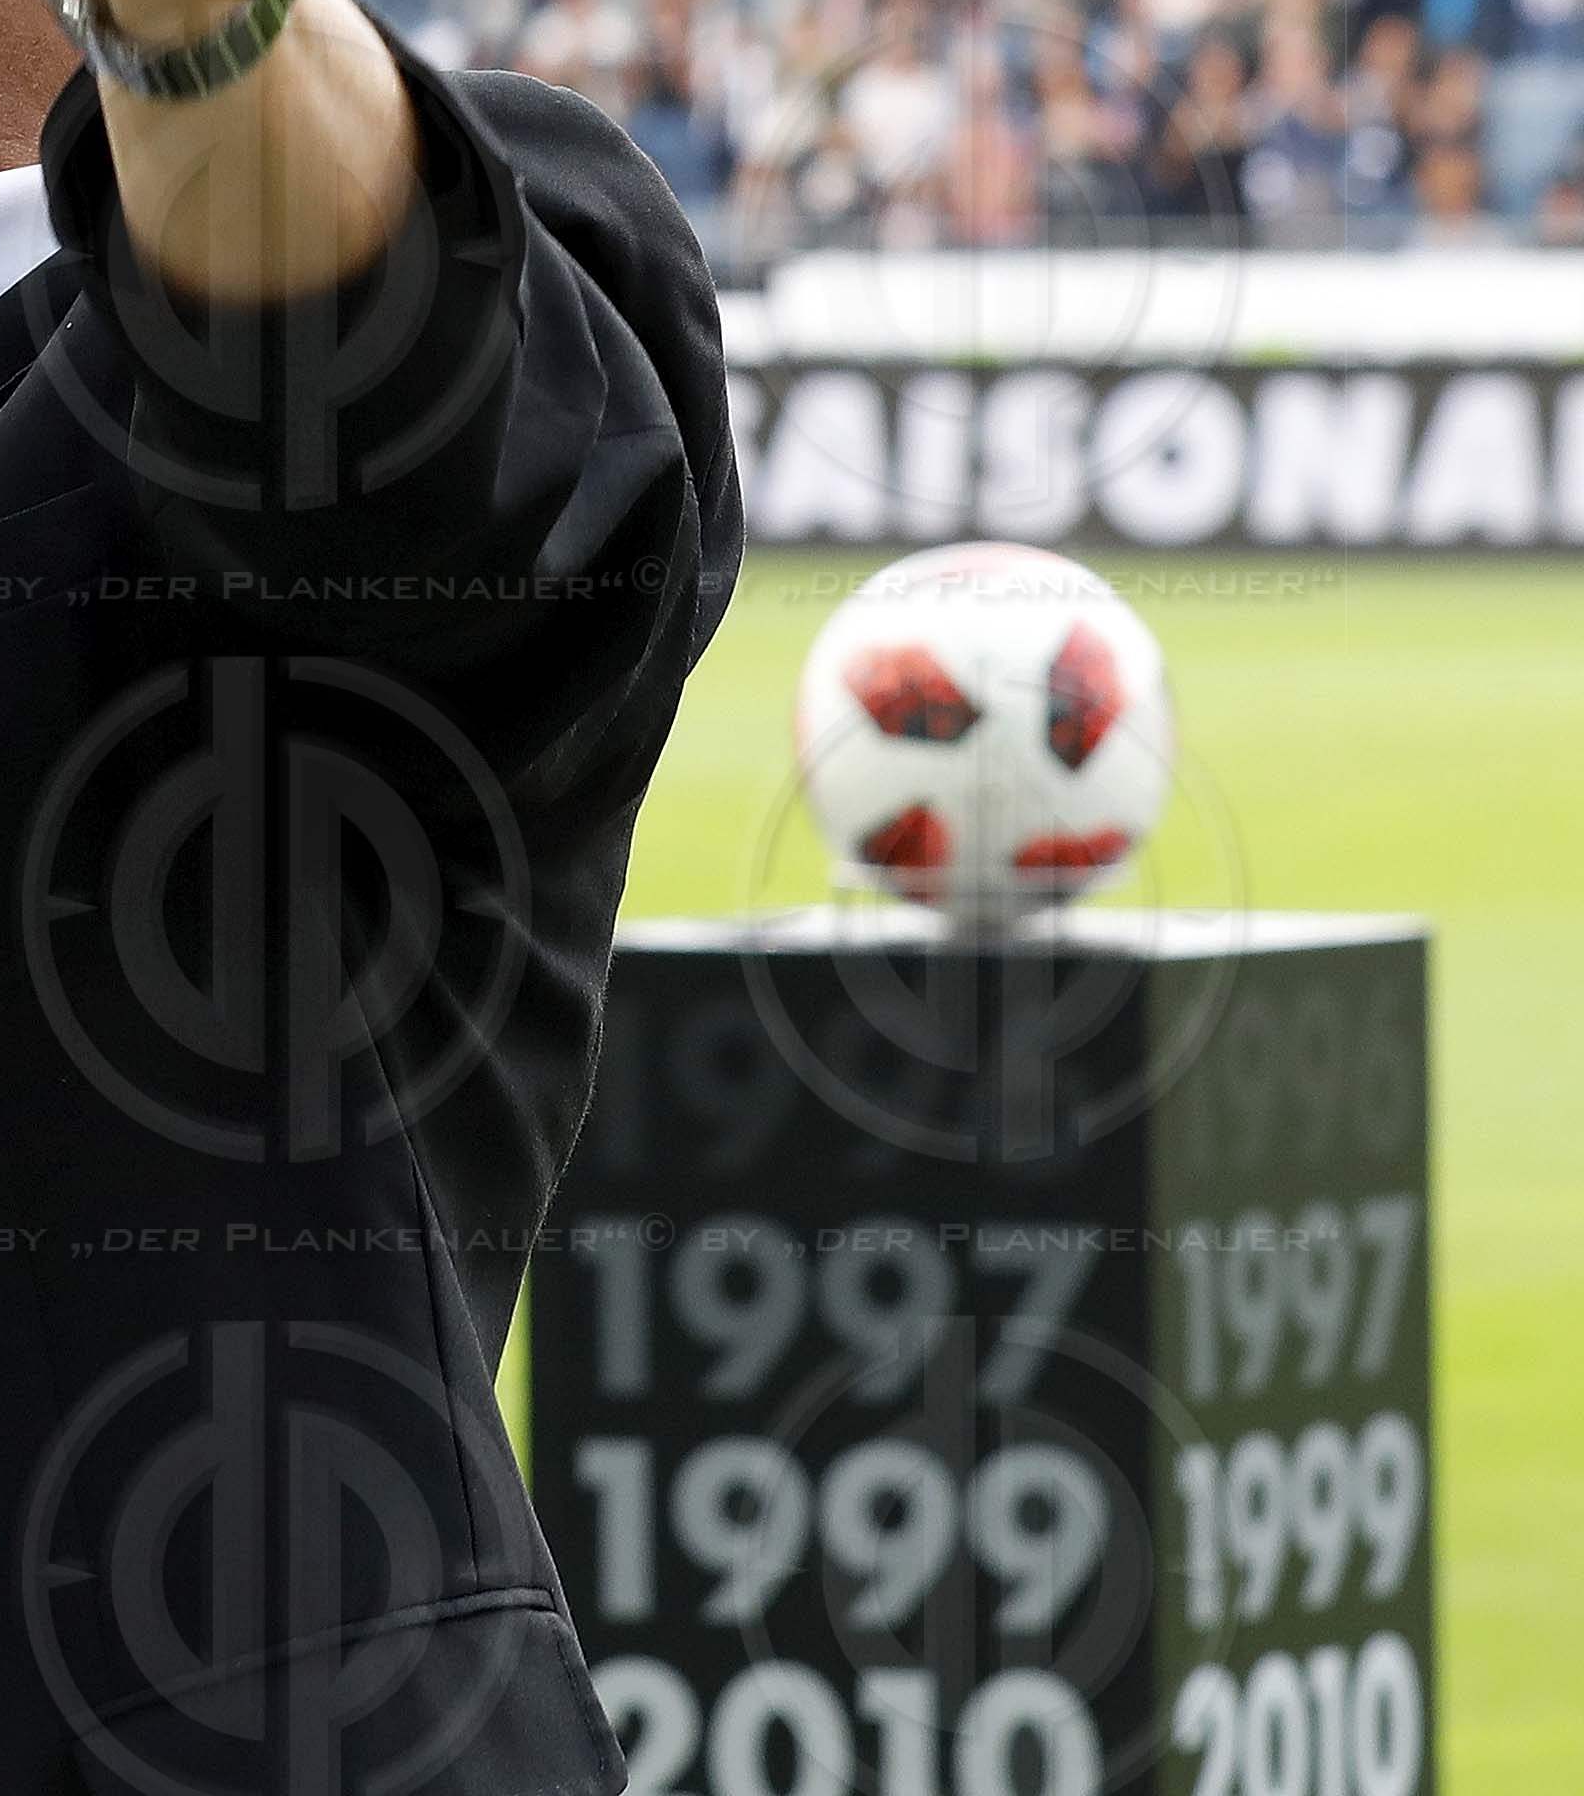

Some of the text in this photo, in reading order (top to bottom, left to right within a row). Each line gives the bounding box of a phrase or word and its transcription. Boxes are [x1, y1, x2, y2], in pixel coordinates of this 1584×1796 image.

[728, 366, 1584, 546] AISONA
[575, 1212, 1106, 1404] 1997
[1176, 1194, 1418, 1402] 1997
[574, 1432, 1112, 1638] 1999
[1176, 1410, 1422, 1632] 1999
[1172, 1628, 1424, 1796] 2010
